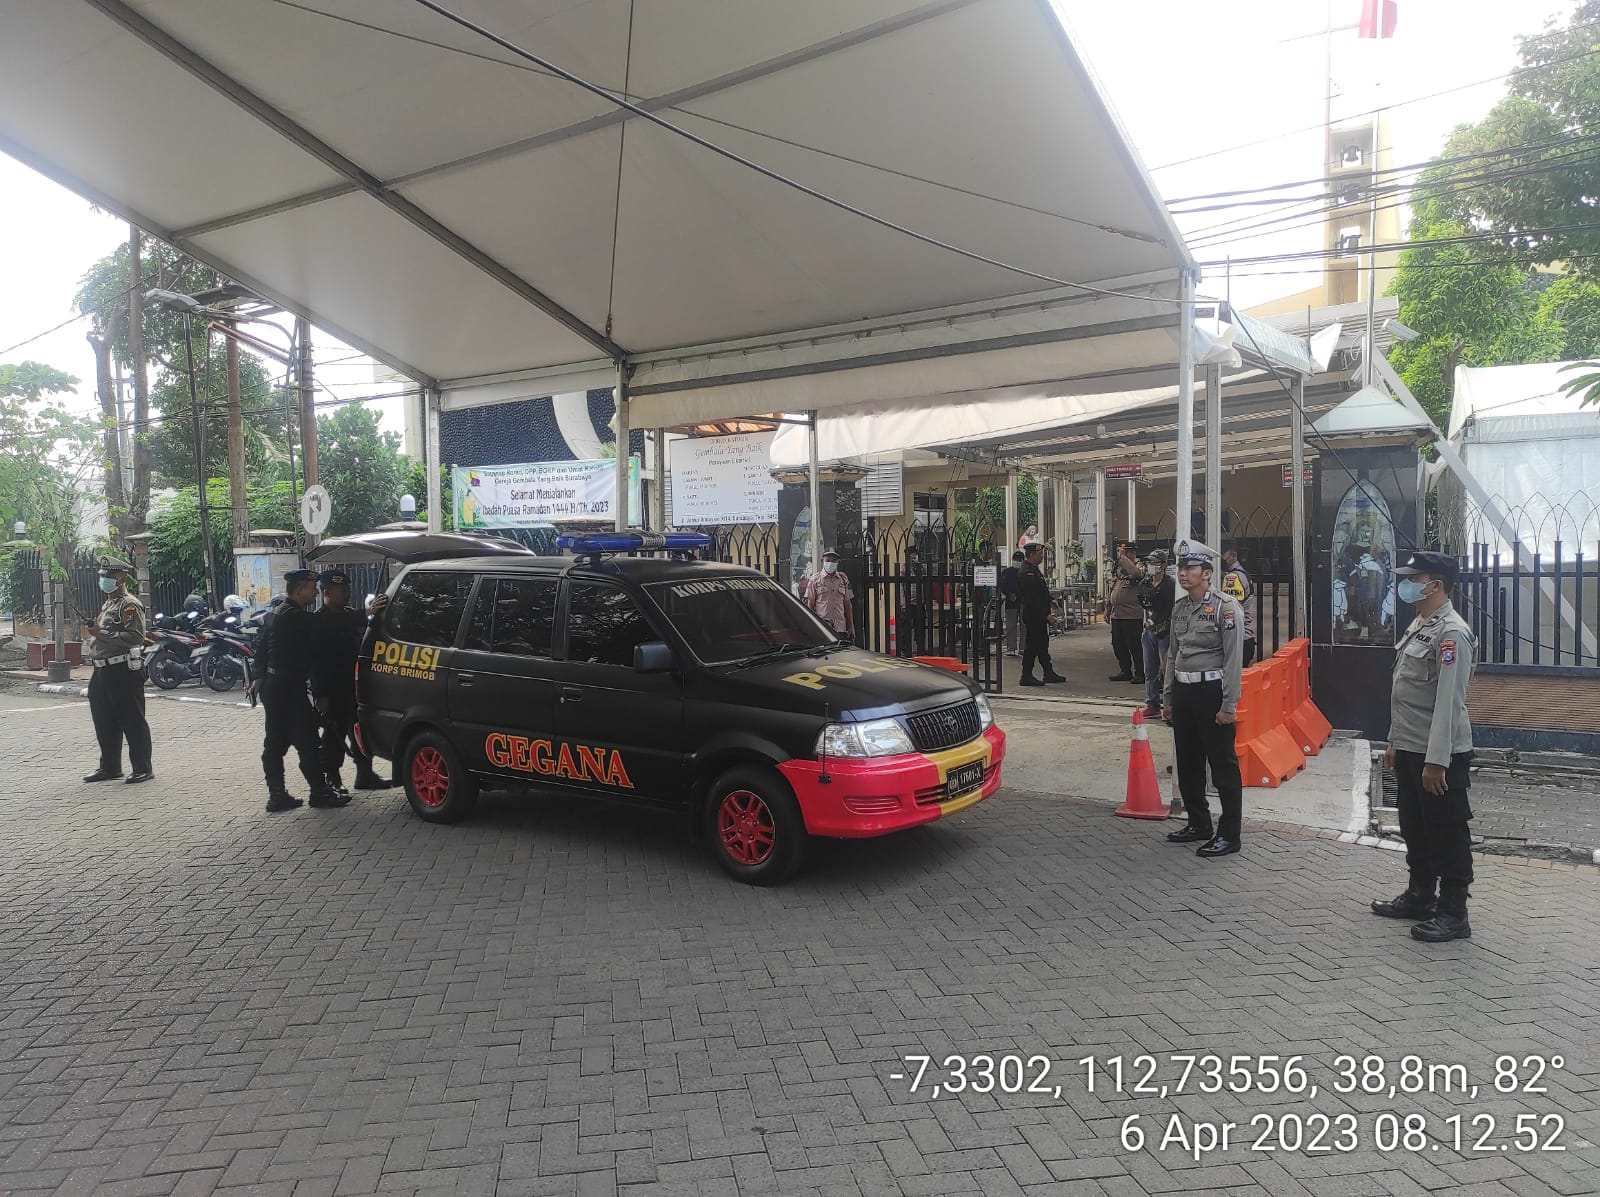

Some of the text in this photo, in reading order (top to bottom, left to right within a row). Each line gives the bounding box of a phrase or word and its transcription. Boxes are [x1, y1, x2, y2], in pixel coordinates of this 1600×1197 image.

[511, 488, 576, 500] Selamat Menjalankan
[482, 504, 502, 516] Ibadah
[502, 504, 521, 516] Puasa
[522, 503, 551, 515] Ramadan
[552, 503, 569, 515] 1444
[591, 500, 609, 513] 2023
[671, 579, 778, 598] KORPS BRIMOB
[372, 640, 441, 671] POLISI
[371, 662, 435, 681] KORPS BRIMOB
[485, 732, 635, 788] GEGANA
